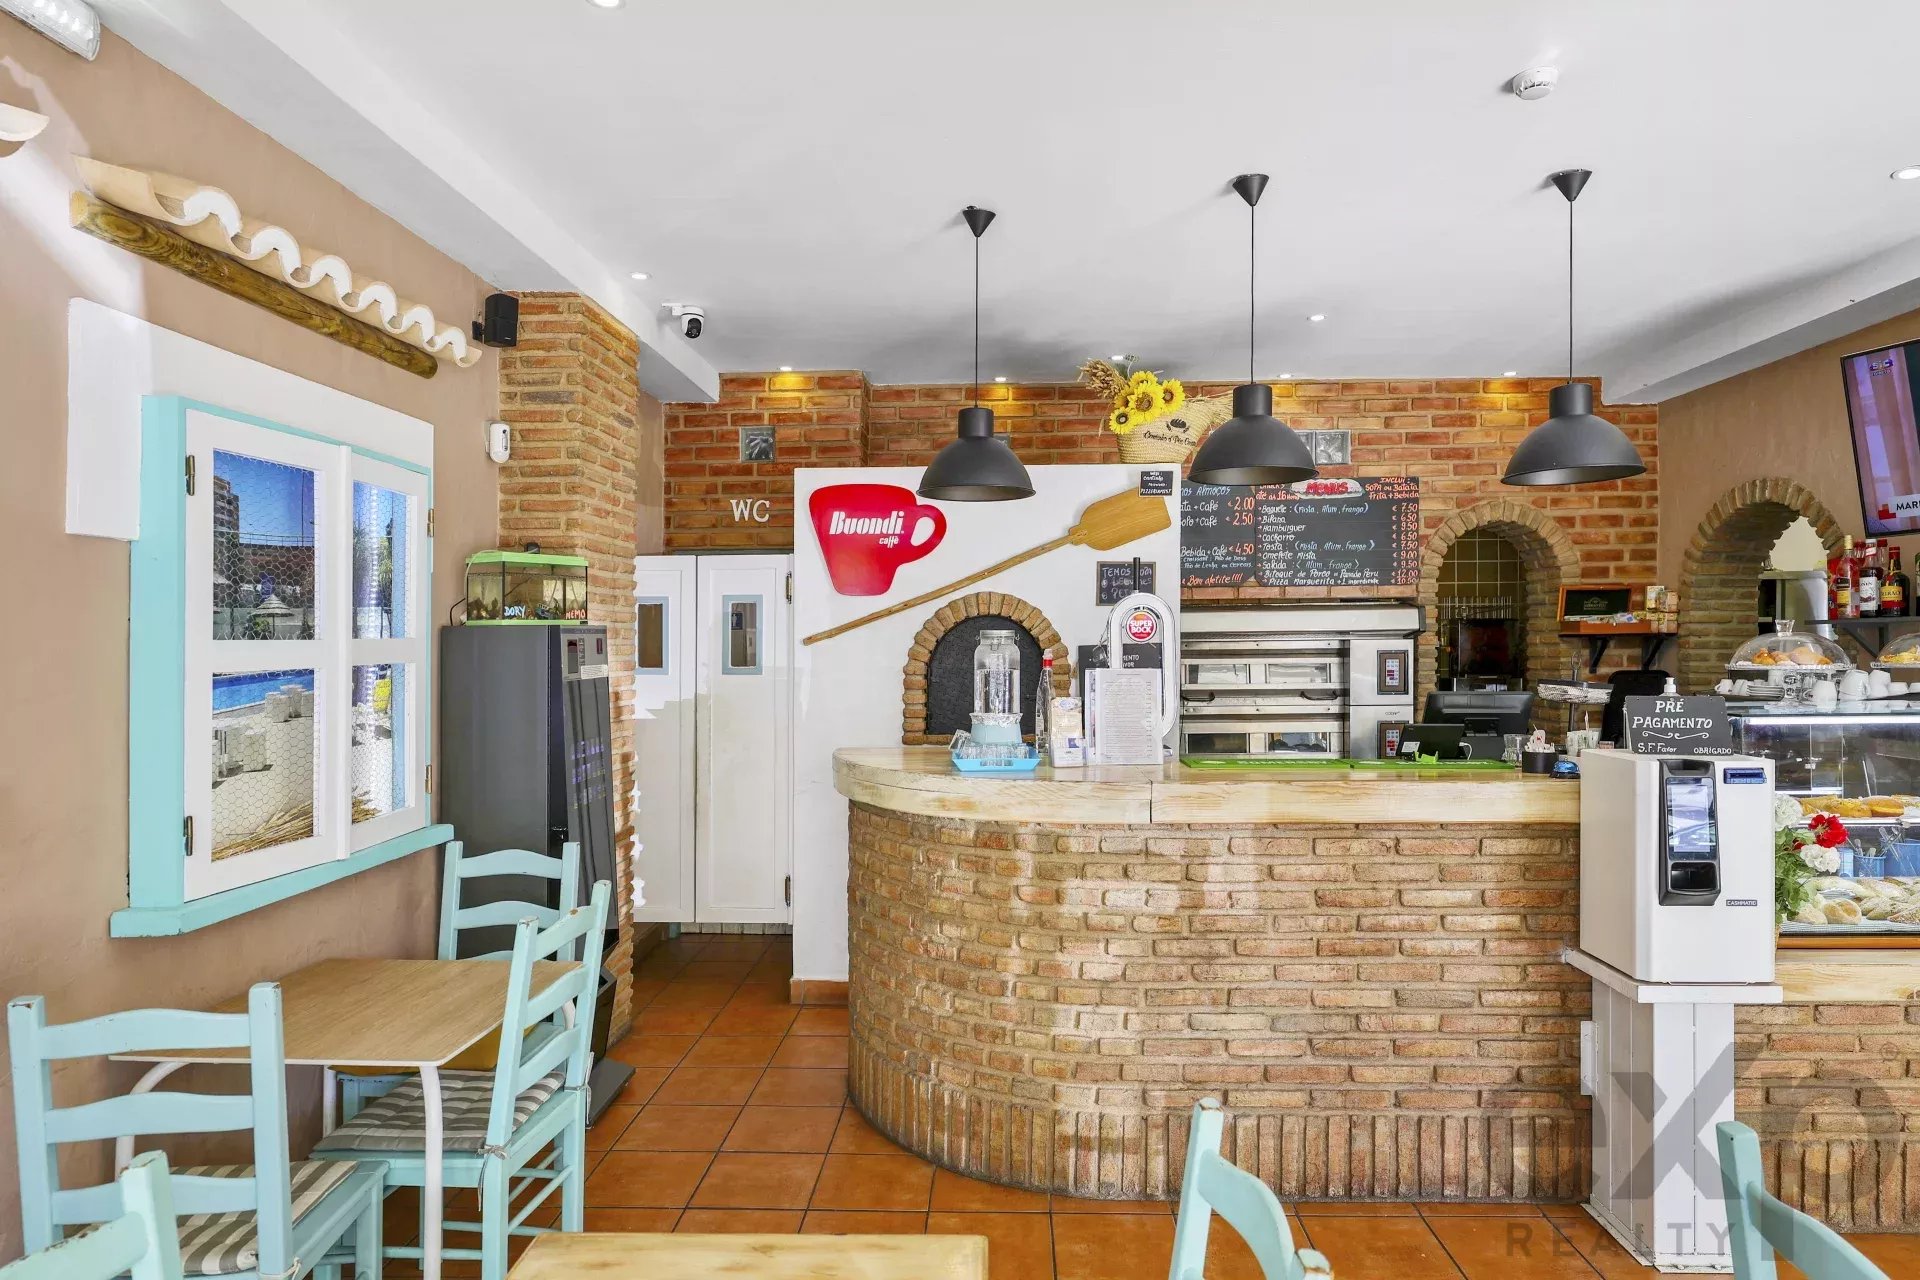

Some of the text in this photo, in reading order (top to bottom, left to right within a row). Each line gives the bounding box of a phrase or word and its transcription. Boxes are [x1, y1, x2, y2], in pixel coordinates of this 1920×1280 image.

[1200, 500, 1218, 512] Café
[1234, 496, 1254, 510] 2.00
[1401, 502, 1418, 512] 7.50
[730, 499, 770, 522] WC
[829, 511, 905, 534] Buondi
[1200, 516, 1218, 527] Café
[1232, 512, 1253, 526] 2.50
[1401, 513, 1417, 521] 6.50
[1263, 524, 1306, 534] Hamburguer
[1401, 522, 1418, 531] 9.50
[879, 536, 899, 548] caffè
[1262, 533, 1295, 542] Cachorro
[1401, 531, 1417, 540] 6.50
[1181, 546, 1206, 557] Bebida
[1235, 543, 1254, 555] 4.50
[1401, 541, 1418, 550] 7.50
[1401, 550, 1418, 559] 9.00
[1102, 566, 1152, 578] TEMOS OPA
[1264, 570, 1293, 578] Bitoque
[1363, 568, 1378, 577] Peru
[1397, 569, 1418, 577] 12.00
[504, 605, 526, 618] DORY
[566, 609, 586, 619] NEMO
[1655, 698, 1684, 713] PRÉ
[1632, 716, 1712, 728] PAGAMENTO
[1657, 742, 1677, 752] Favor
[1694, 746, 1732, 754] OBRIGADO
